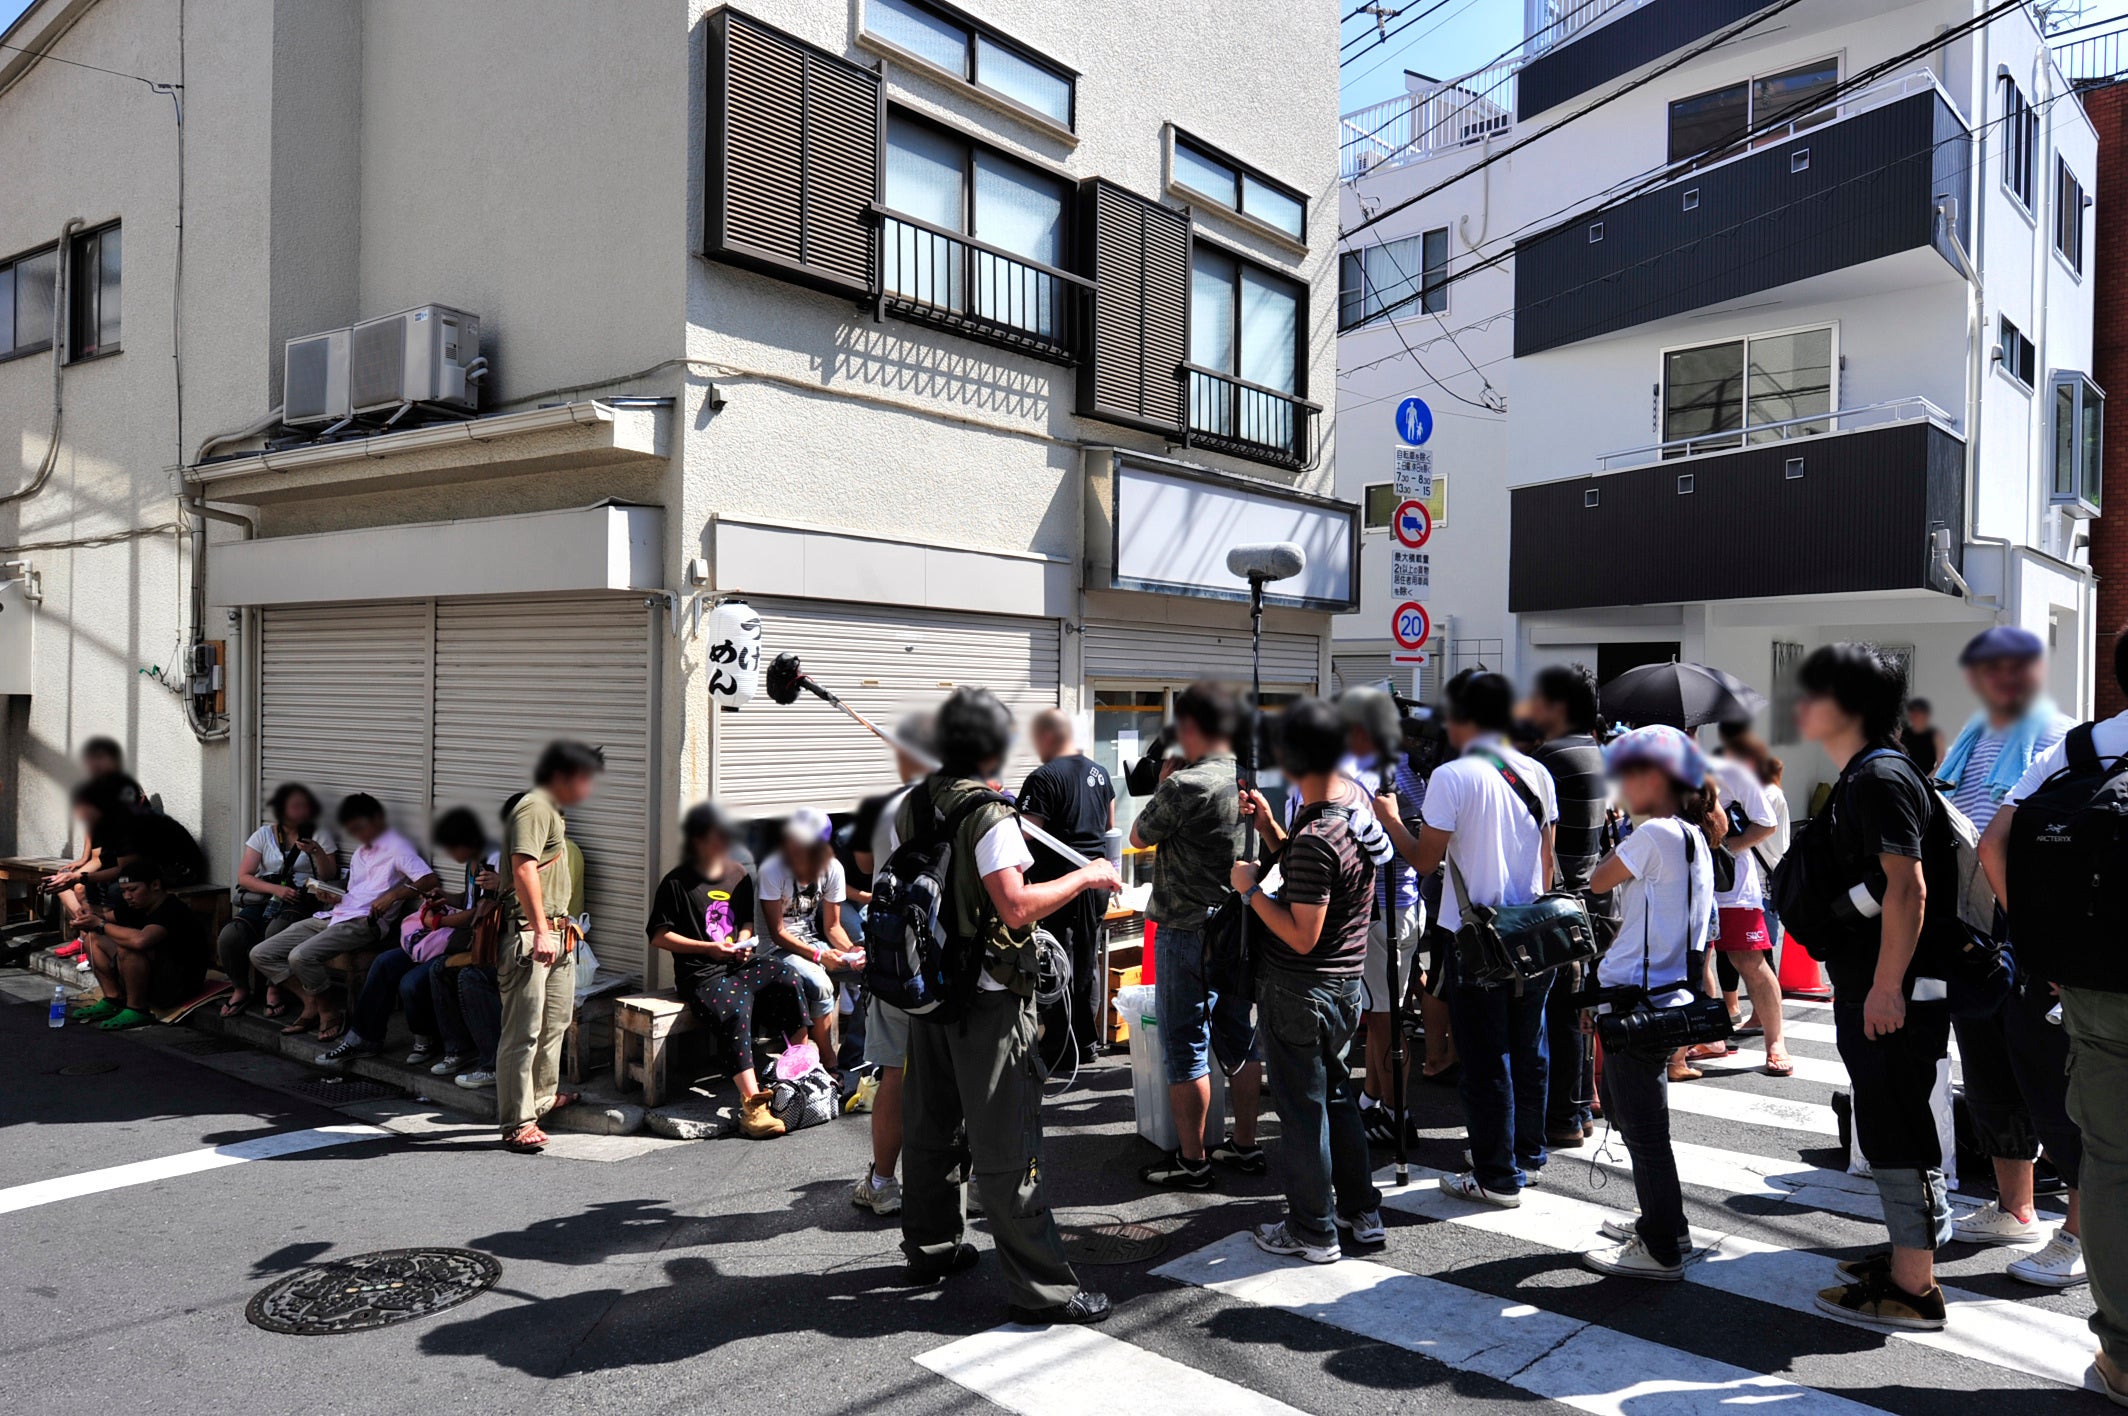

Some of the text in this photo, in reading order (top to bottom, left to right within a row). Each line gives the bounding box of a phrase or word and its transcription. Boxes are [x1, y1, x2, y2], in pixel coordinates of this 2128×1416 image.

[1396, 450, 1431, 462] 自転車を除く
[1423, 486, 1431, 496] 15
[1394, 552, 1429, 564] 最大積載量
[1394, 586, 1413, 597] を除く
[1401, 615, 1422, 637] 20
[709, 639, 738, 696] めん
